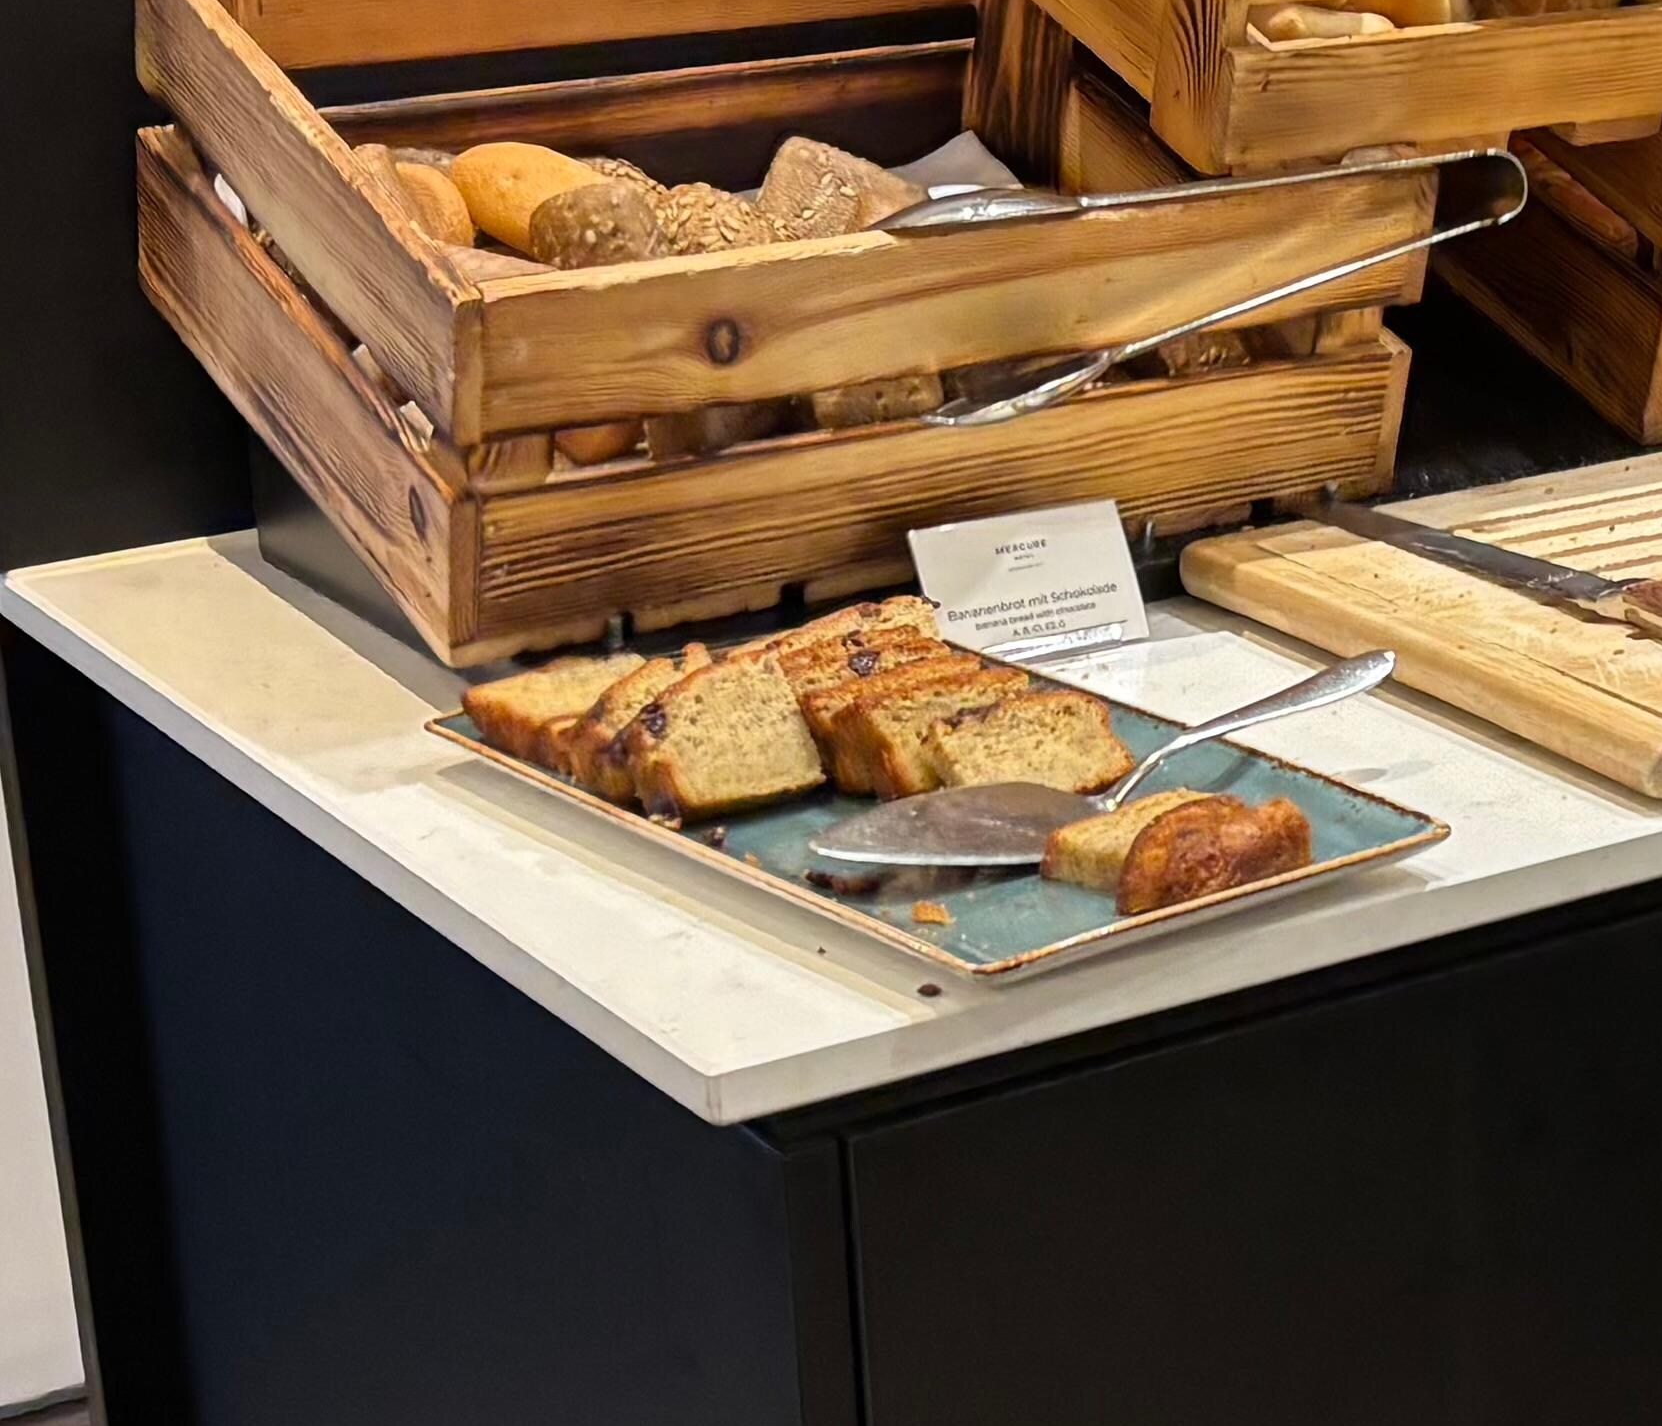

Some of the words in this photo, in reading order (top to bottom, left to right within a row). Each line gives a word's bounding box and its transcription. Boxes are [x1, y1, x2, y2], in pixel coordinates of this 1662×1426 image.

[947, 599, 1027, 623] Bananenbrot
[1028, 593, 1049, 609] mit
[1050, 582, 1118, 604] Schokolade
